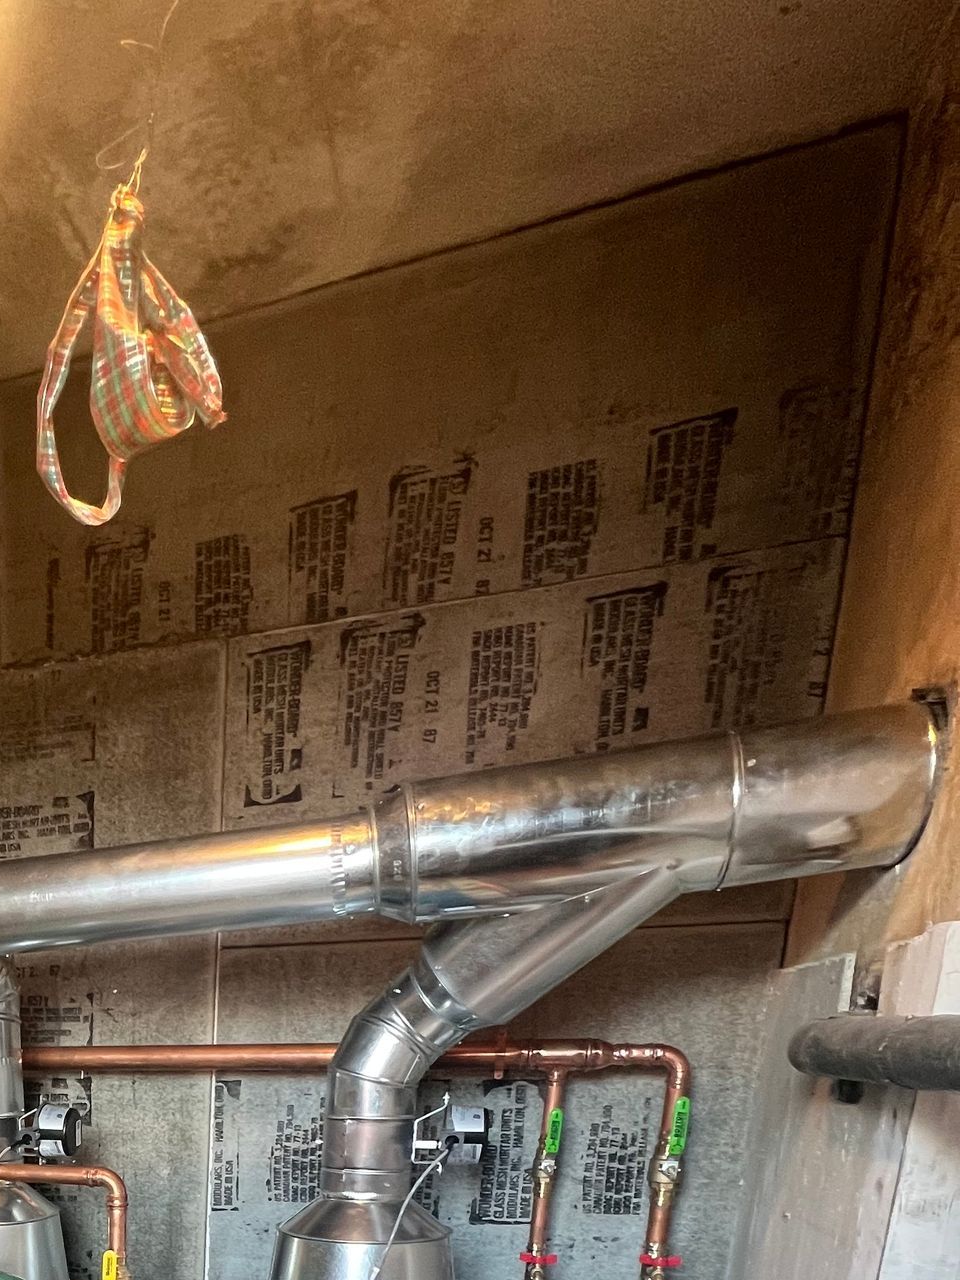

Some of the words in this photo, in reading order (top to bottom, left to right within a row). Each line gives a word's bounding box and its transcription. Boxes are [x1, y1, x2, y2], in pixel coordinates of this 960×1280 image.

[391, 654, 410, 695] LISTED
[425, 670, 440, 695] OCT
[424, 699, 439, 714] 21
[422, 728, 438, 745] 87
[500, 1108, 513, 1132] UNITS
[283, 1145, 292, 1170] PATENT
[497, 1132, 511, 1167] MORTAR
[225, 1160, 234, 1176] USA
[595, 1150, 607, 1177] PATENT
[274, 1167, 282, 1191] PATENT
[495, 1168, 508, 1191] MESH
[582, 1175, 593, 1202] PATENT
[224, 1185, 233, 1206] MADE
[493, 1192, 506, 1219] GLASS
[519, 1195, 530, 1219] MADE
